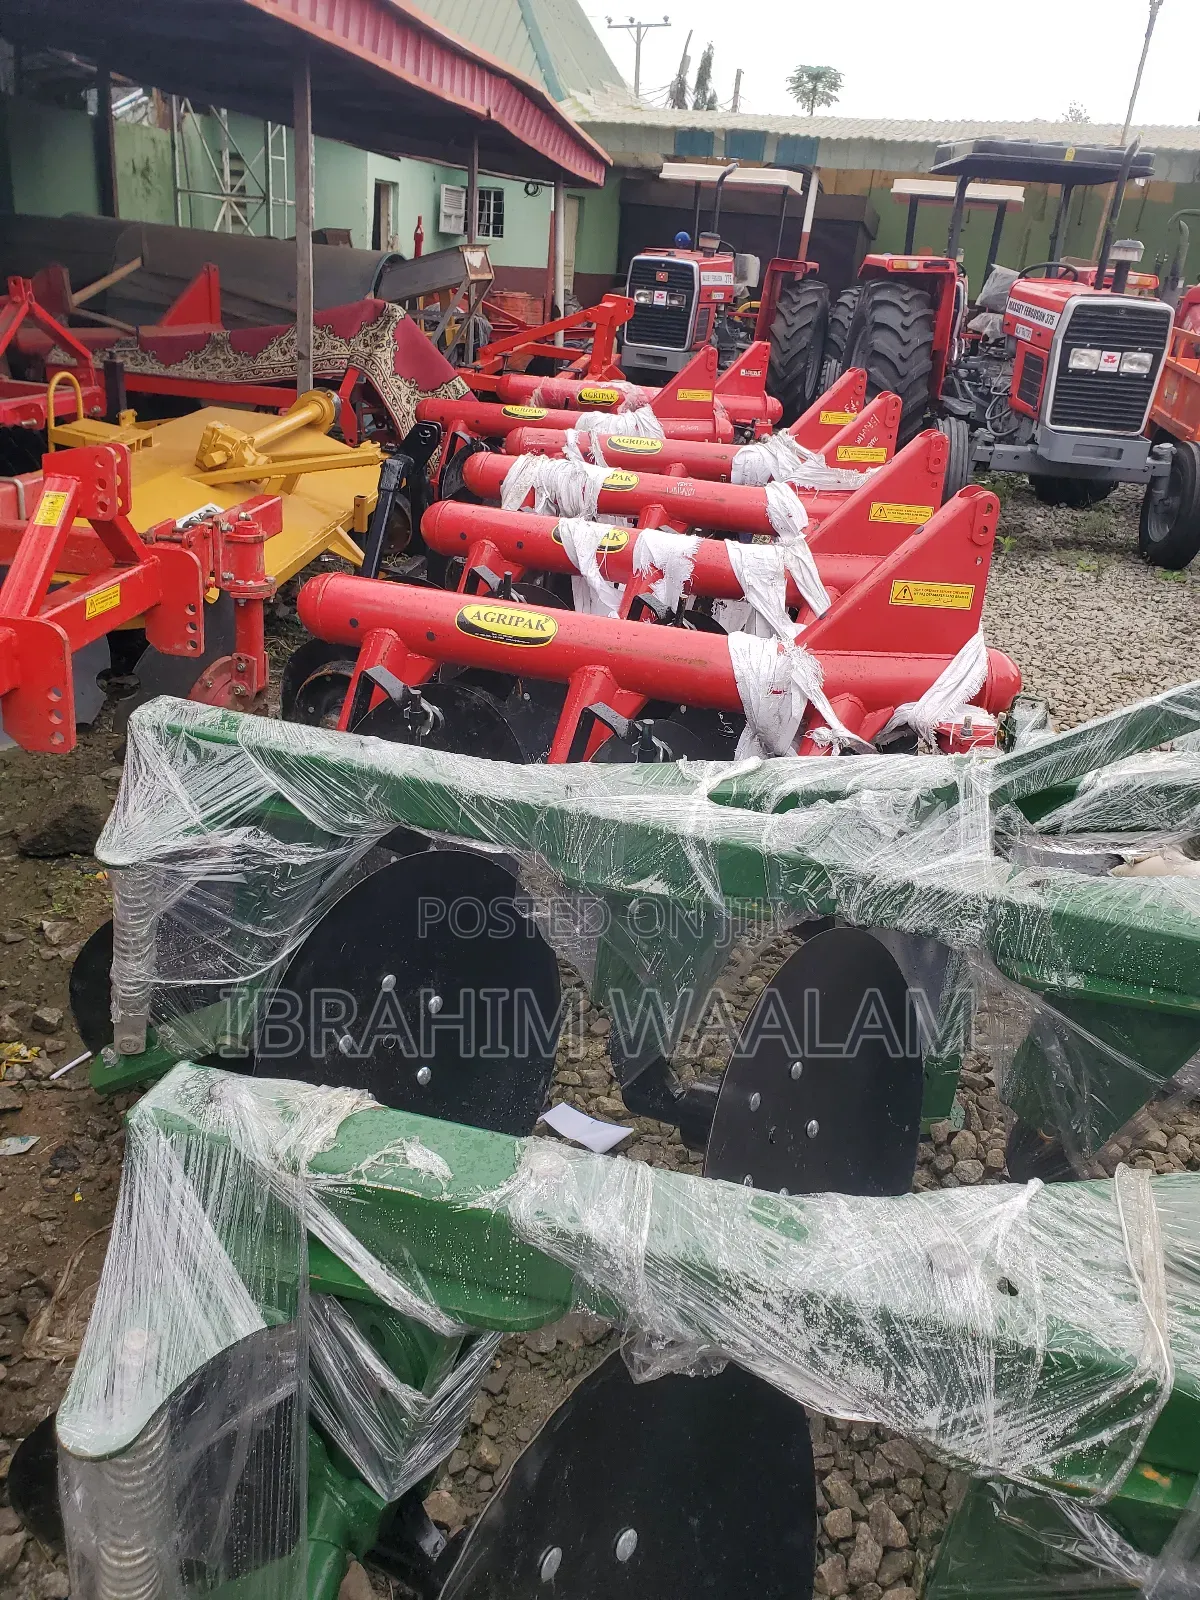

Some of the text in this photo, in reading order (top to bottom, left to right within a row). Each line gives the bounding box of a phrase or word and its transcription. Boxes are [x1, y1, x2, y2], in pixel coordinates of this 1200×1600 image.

[584, 391, 616, 401] AGRIPAK
[508, 405, 544, 415] AGRIPAK
[616, 438, 657, 448] AGRIPAK
[470, 610, 547, 632] AGRIPAK
